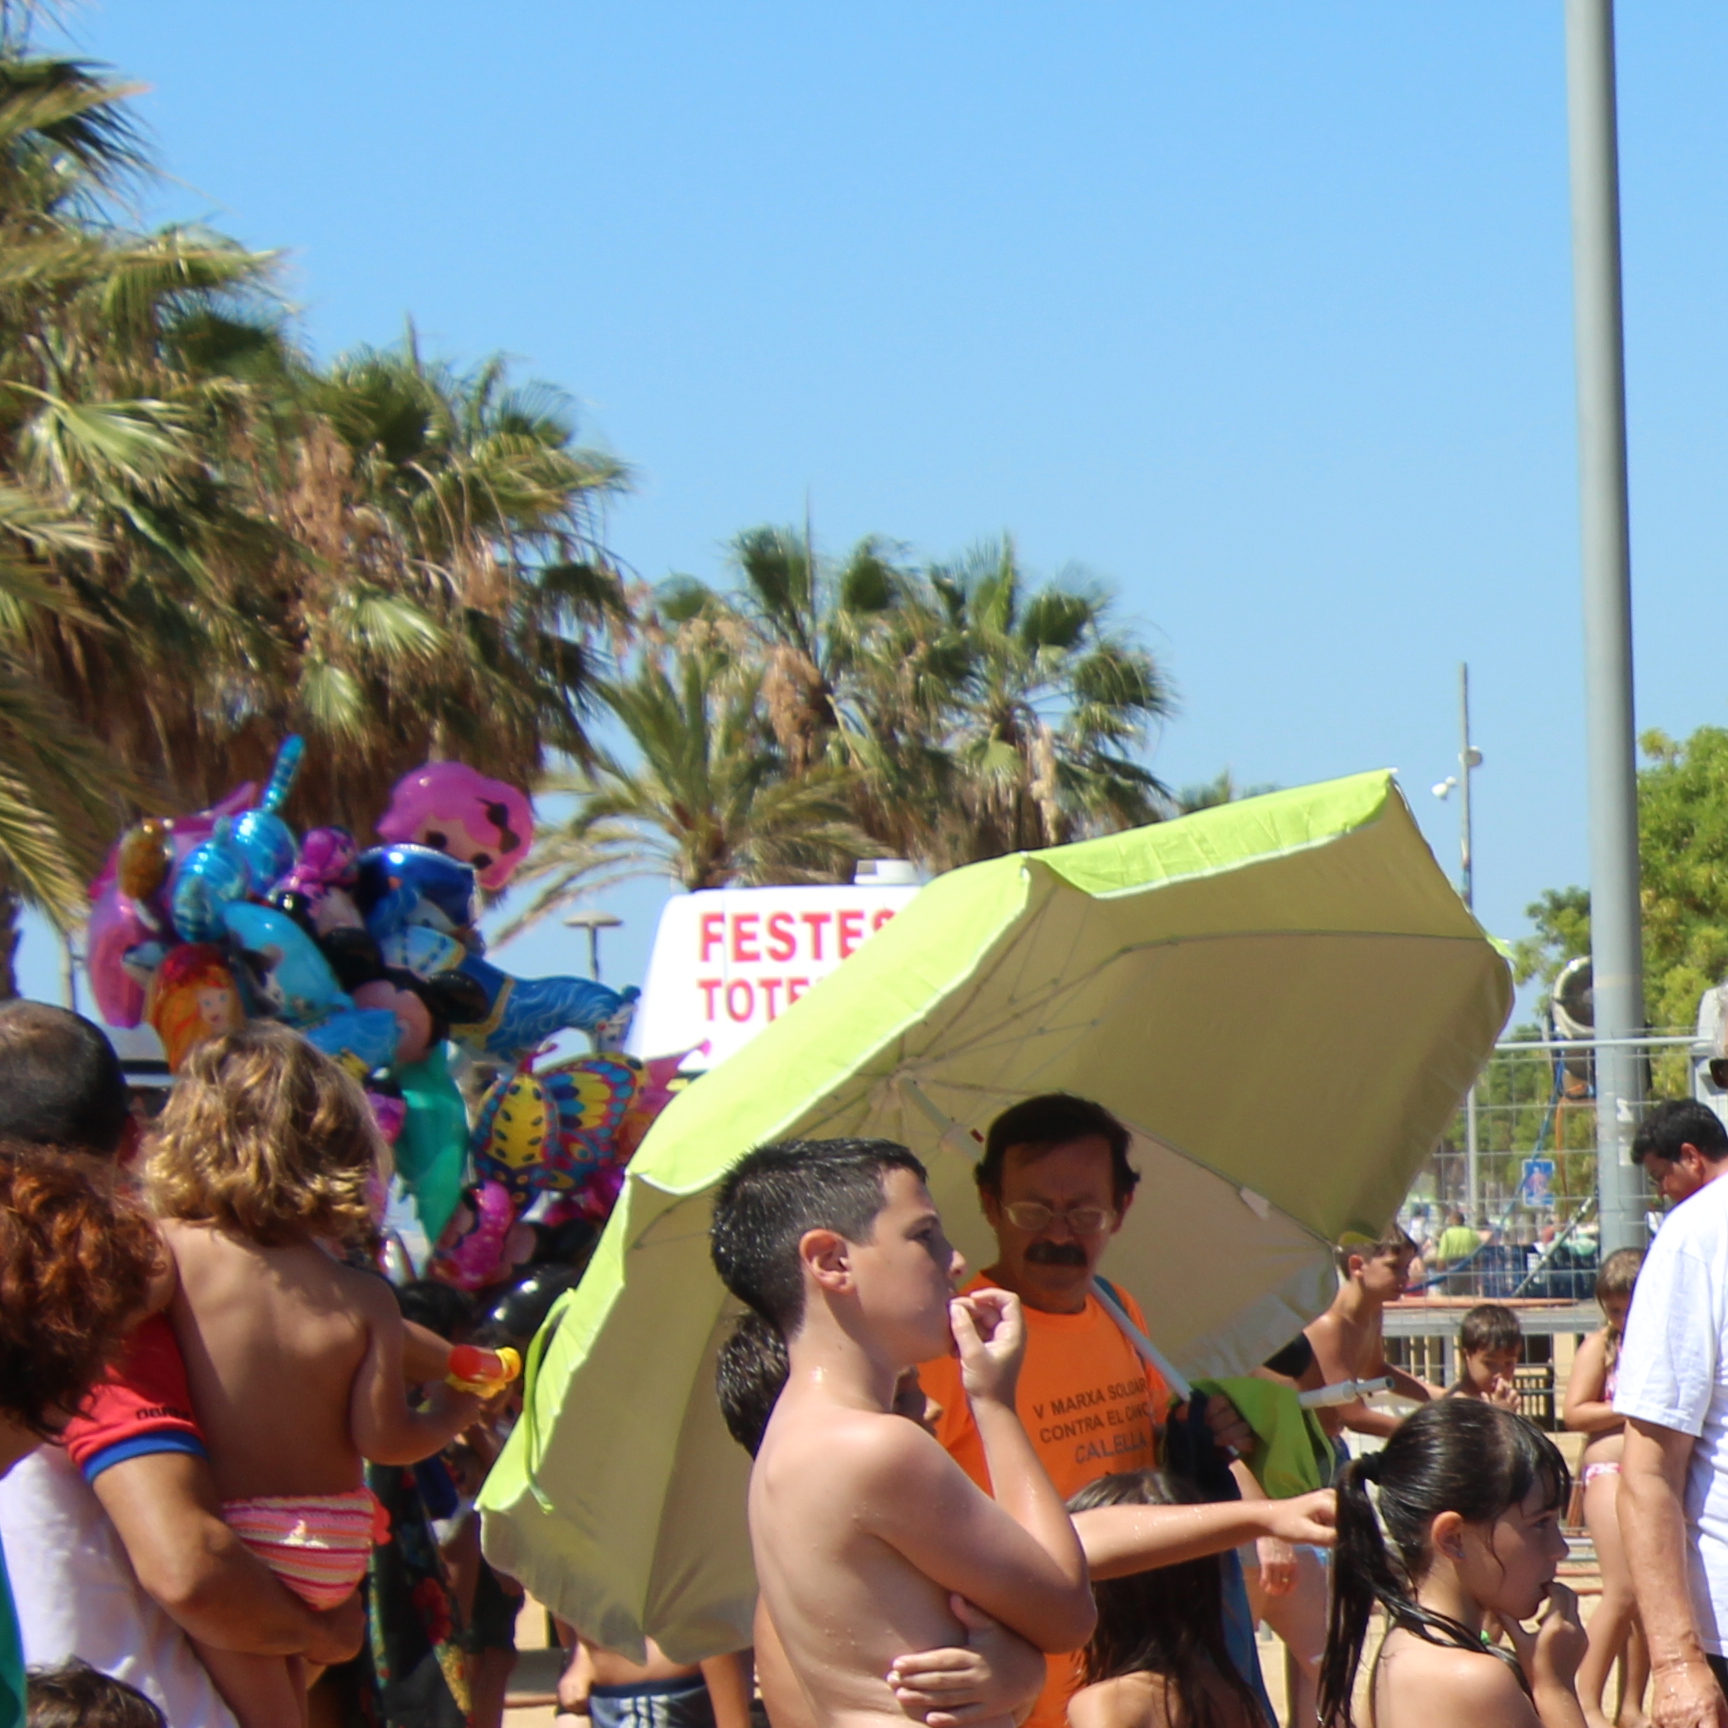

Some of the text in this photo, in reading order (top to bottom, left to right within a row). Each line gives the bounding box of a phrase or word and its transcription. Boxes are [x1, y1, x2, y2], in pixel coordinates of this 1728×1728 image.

[697, 977, 825, 1023] TOTE
[1050, 1388, 1106, 1415] MARXA
[1039, 1414, 1104, 1443] CONTRA
[1106, 1408, 1125, 1426] EL
[1075, 1430, 1147, 1464] CALELLA
